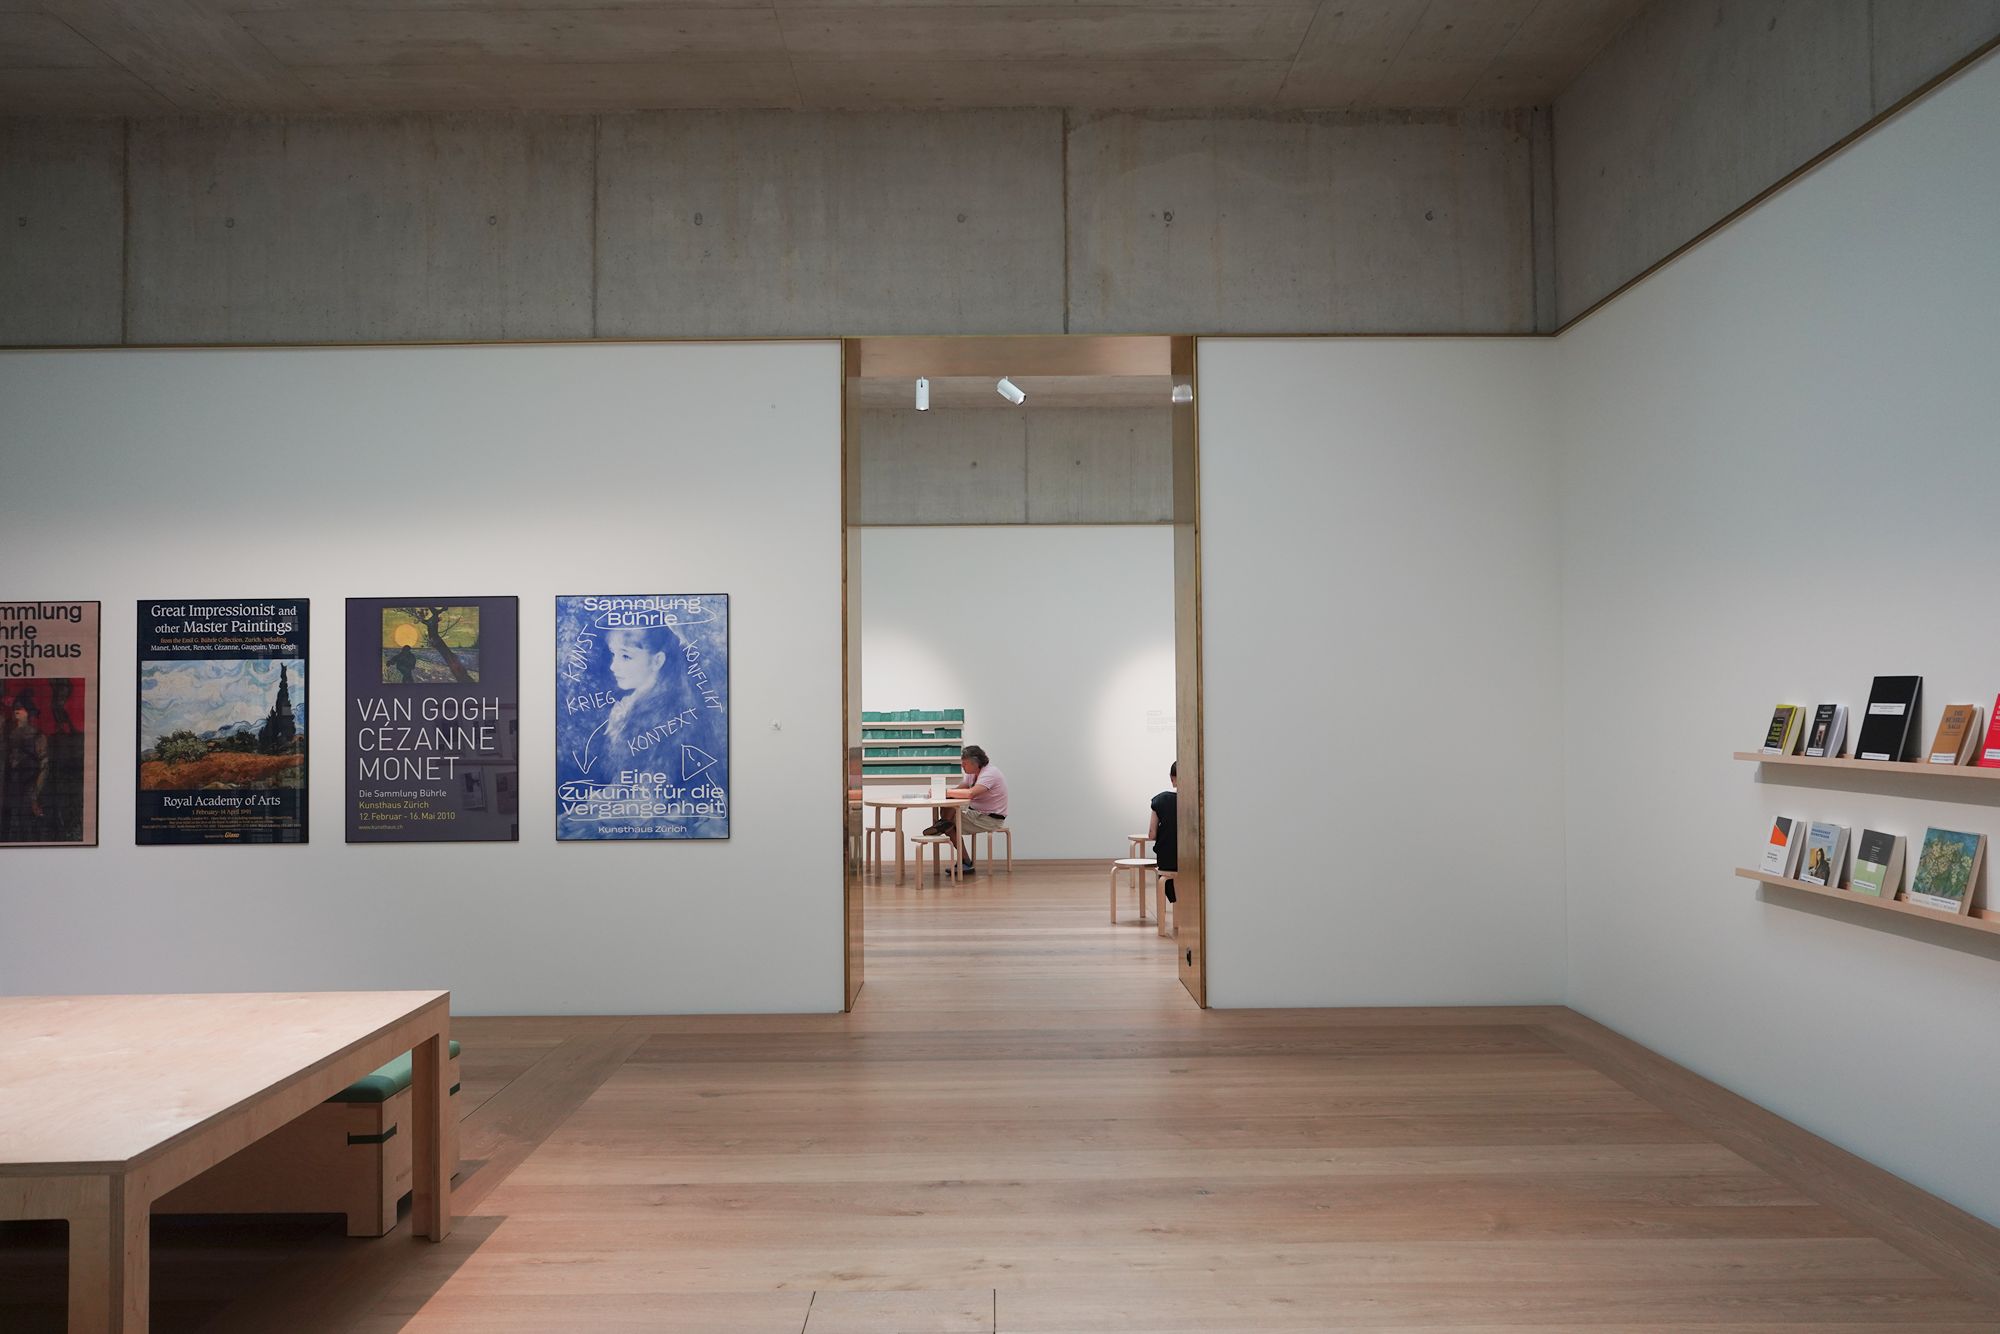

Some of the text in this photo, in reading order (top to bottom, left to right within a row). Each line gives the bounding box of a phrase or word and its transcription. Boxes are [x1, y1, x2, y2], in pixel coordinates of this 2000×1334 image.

[151, 603, 297, 619] Great Impressionist and
[584, 596, 701, 614] Sammlung
[607, 611, 678, 626] Bührle
[155, 620, 292, 635] other Master Paintings
[280, 643, 296, 651] Gogh
[562, 624, 597, 682] KUNST
[682, 639, 723, 712] KONFLIKT
[357, 697, 499, 721] VAN GOGH
[566, 690, 616, 715] KRIEG
[358, 718, 495, 751] CÉZANNE
[627, 708, 699, 757] KONTEXT
[359, 756, 459, 781] MONET
[620, 769, 667, 784] Eine
[360, 789, 447, 799] Die Sammlung Bührle
[562, 785, 724, 800] Zukunft für die
[164, 795, 280, 809] Royal Academy of Arts
[360, 800, 429, 809] Kunsthaus Zürich
[562, 800, 724, 818] Vergangenheit
[422, 812, 435, 820] Mai
[437, 812, 456, 820] 2010
[598, 825, 687, 833] Kunsthaus Zürich
